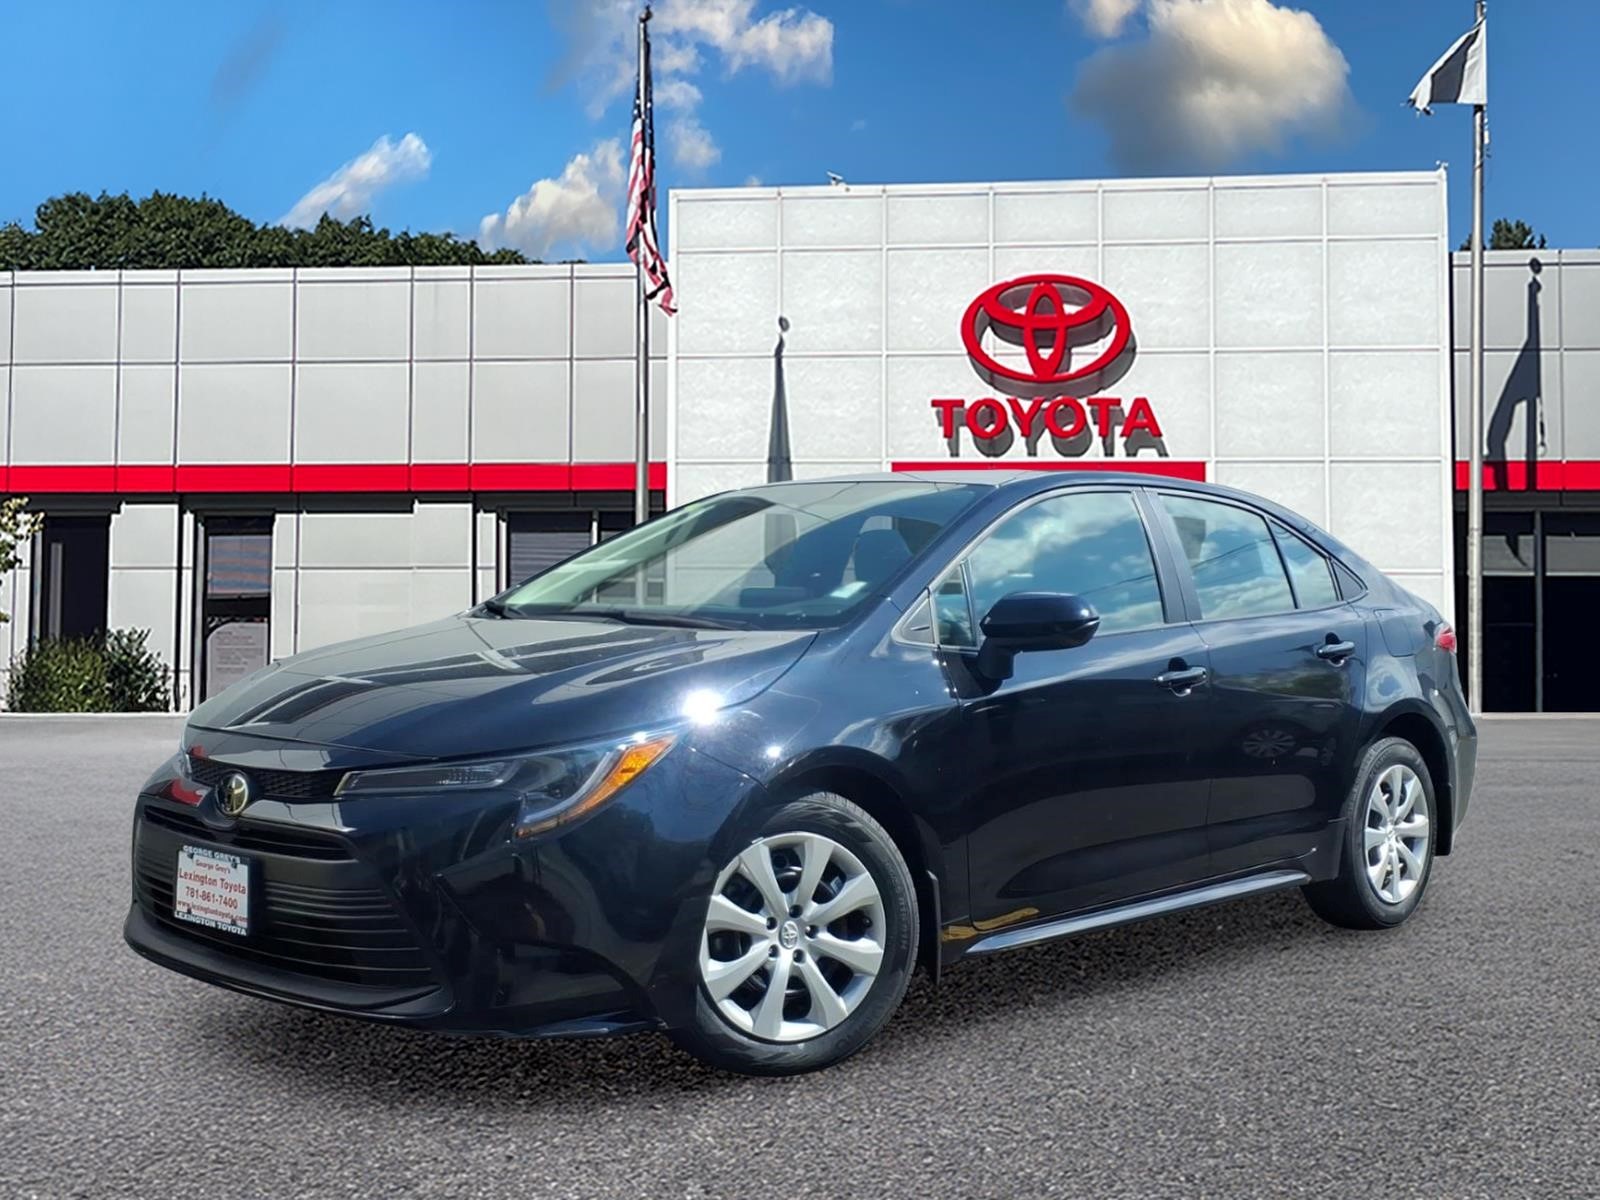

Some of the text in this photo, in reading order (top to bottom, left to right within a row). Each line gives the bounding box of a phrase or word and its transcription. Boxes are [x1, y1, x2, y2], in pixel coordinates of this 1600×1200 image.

[931, 395, 1163, 440] TOYOTA
[183, 845, 213, 858] GEORGE
[195, 859, 214, 870] George
[179, 867, 246, 894] Lexington Toyota
[185, 886, 238, 909] 781-861-7400
[174, 911, 247, 936] LEXINGTON TOYOTA
